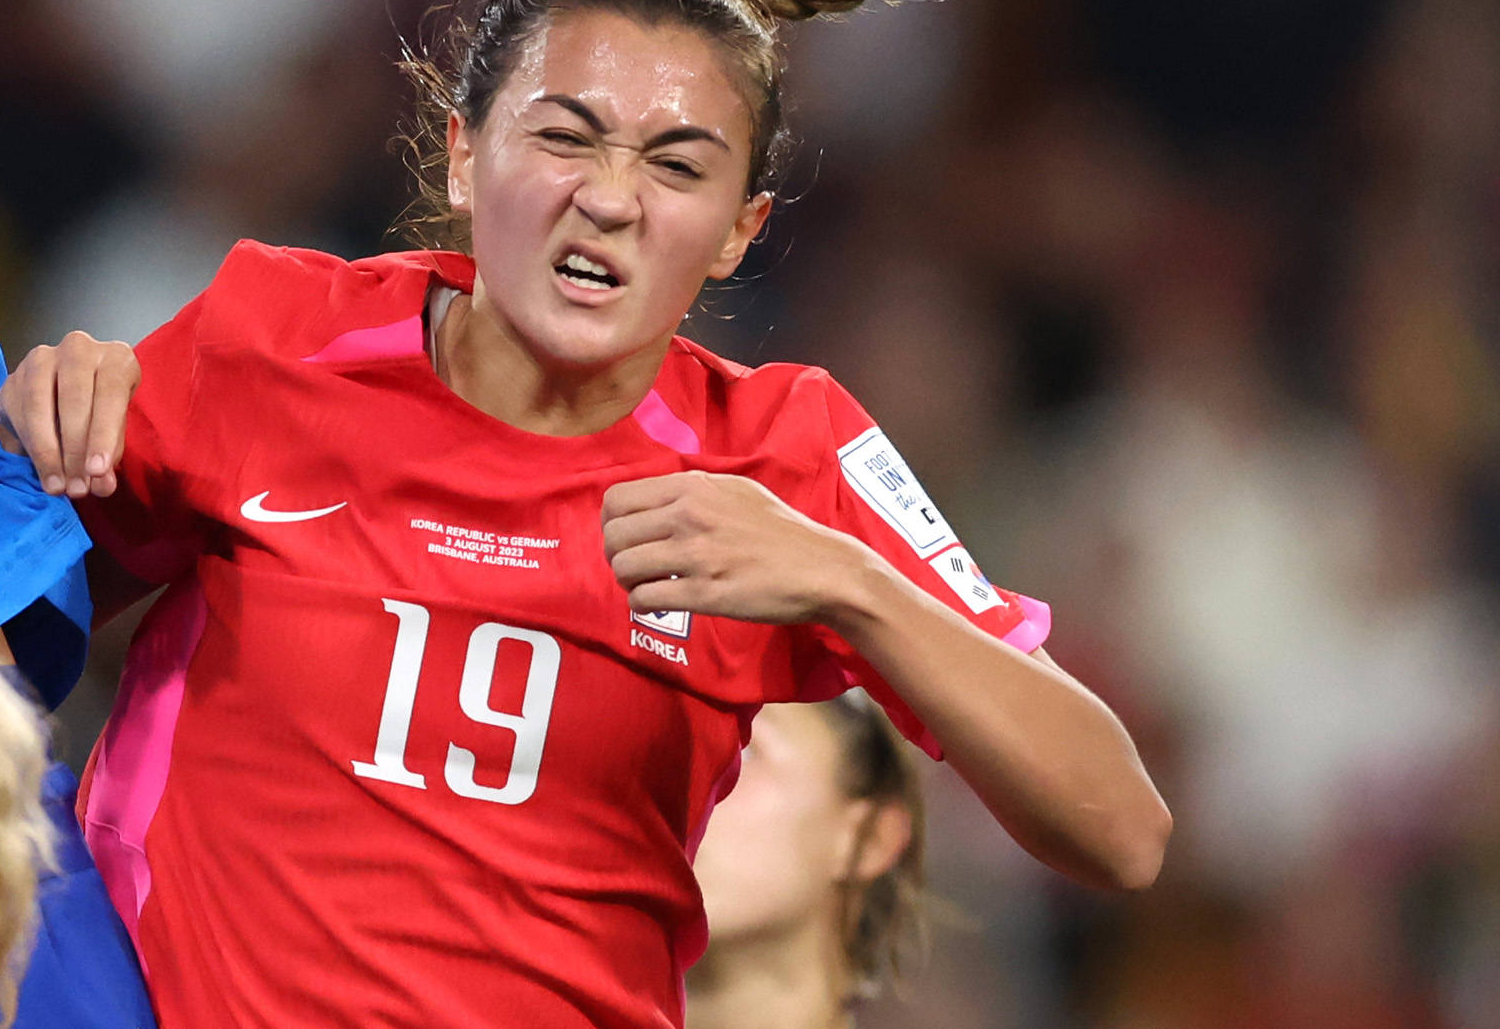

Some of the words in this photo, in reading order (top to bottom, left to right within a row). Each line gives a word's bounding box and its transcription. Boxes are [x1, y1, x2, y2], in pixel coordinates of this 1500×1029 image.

[410, 519, 444, 533] KOREA
[446, 525, 495, 543] REPUBLIC
[510, 536, 560, 549] GERMANY
[445, 537, 452, 546] 3
[453, 539, 496, 554] AUGUST
[498, 546, 524, 558] 2023
[428, 543, 480, 563] BRISBANE,
[482, 554, 540, 569] AUSTRALIA
[630, 628, 689, 666] KOREA
[350, 597, 561, 805] 19
